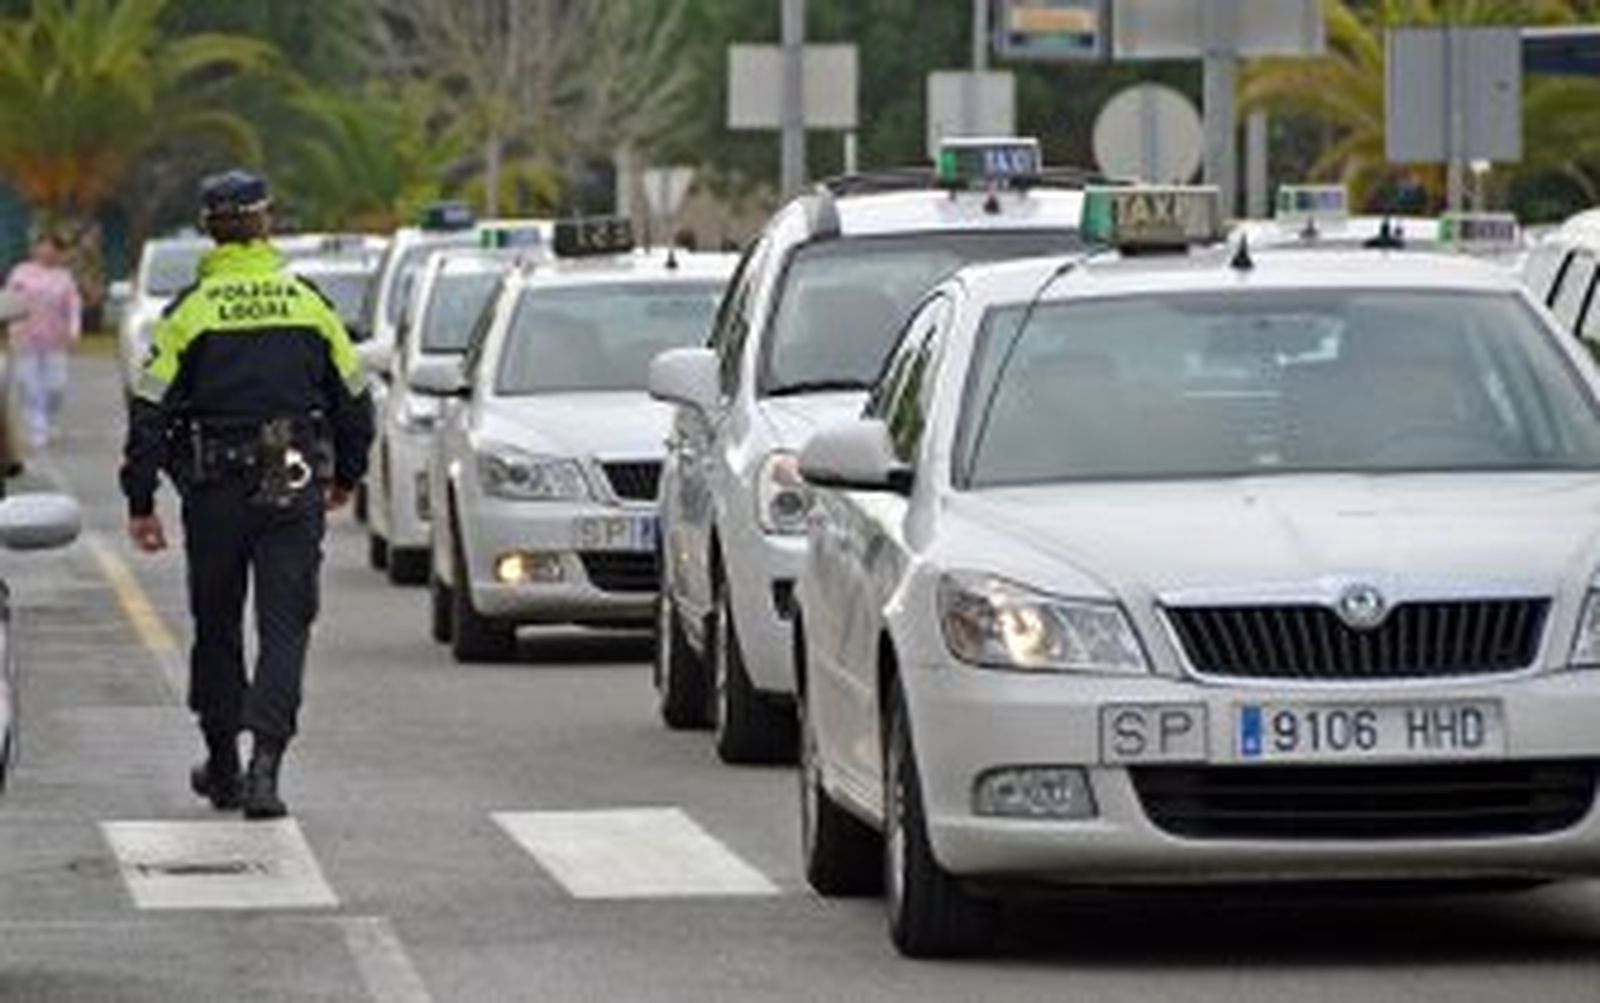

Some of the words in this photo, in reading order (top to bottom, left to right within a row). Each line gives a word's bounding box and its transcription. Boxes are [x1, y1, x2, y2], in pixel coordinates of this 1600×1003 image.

[219, 300, 289, 321] LOCAL
[1272, 708, 1378, 754] 9106
[1406, 708, 1485, 750] HHD
